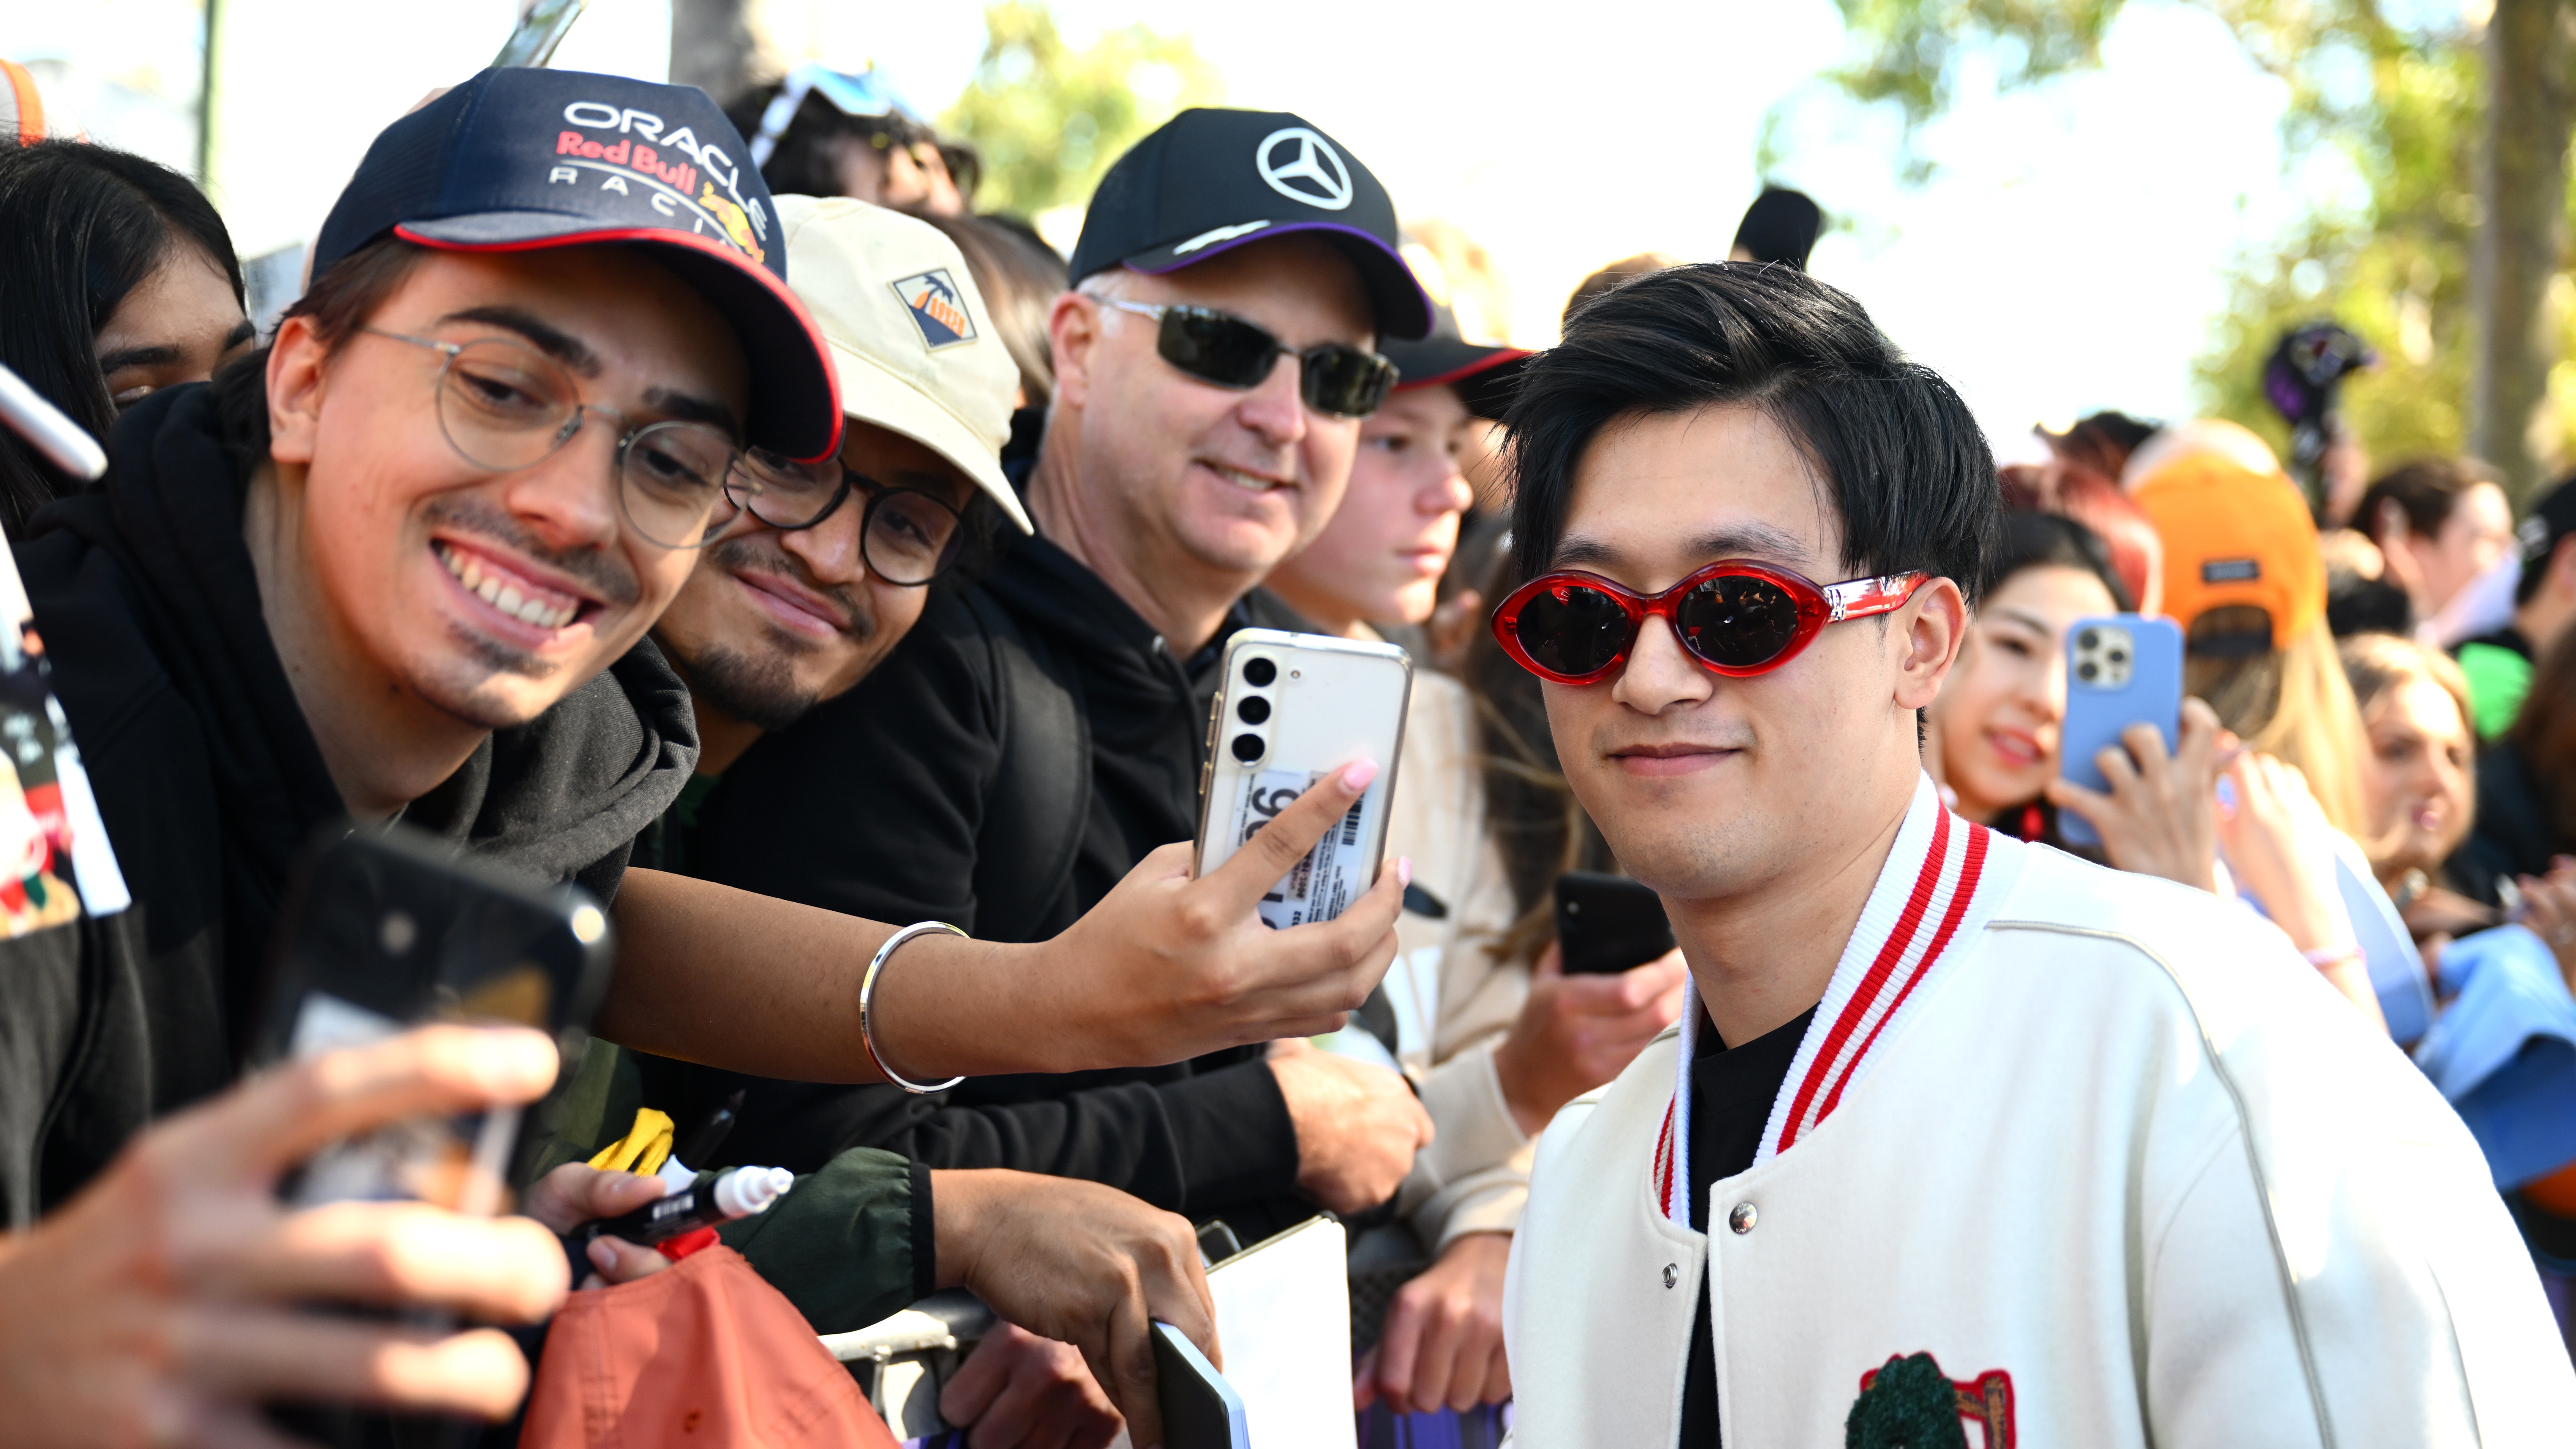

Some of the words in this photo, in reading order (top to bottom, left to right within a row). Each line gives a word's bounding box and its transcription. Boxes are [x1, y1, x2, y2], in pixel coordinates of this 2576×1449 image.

[556, 131, 630, 165] Red
[631, 144, 697, 195] Bull
[564, 101, 767, 241] ORACLE
[549, 166, 726, 246] RACI
